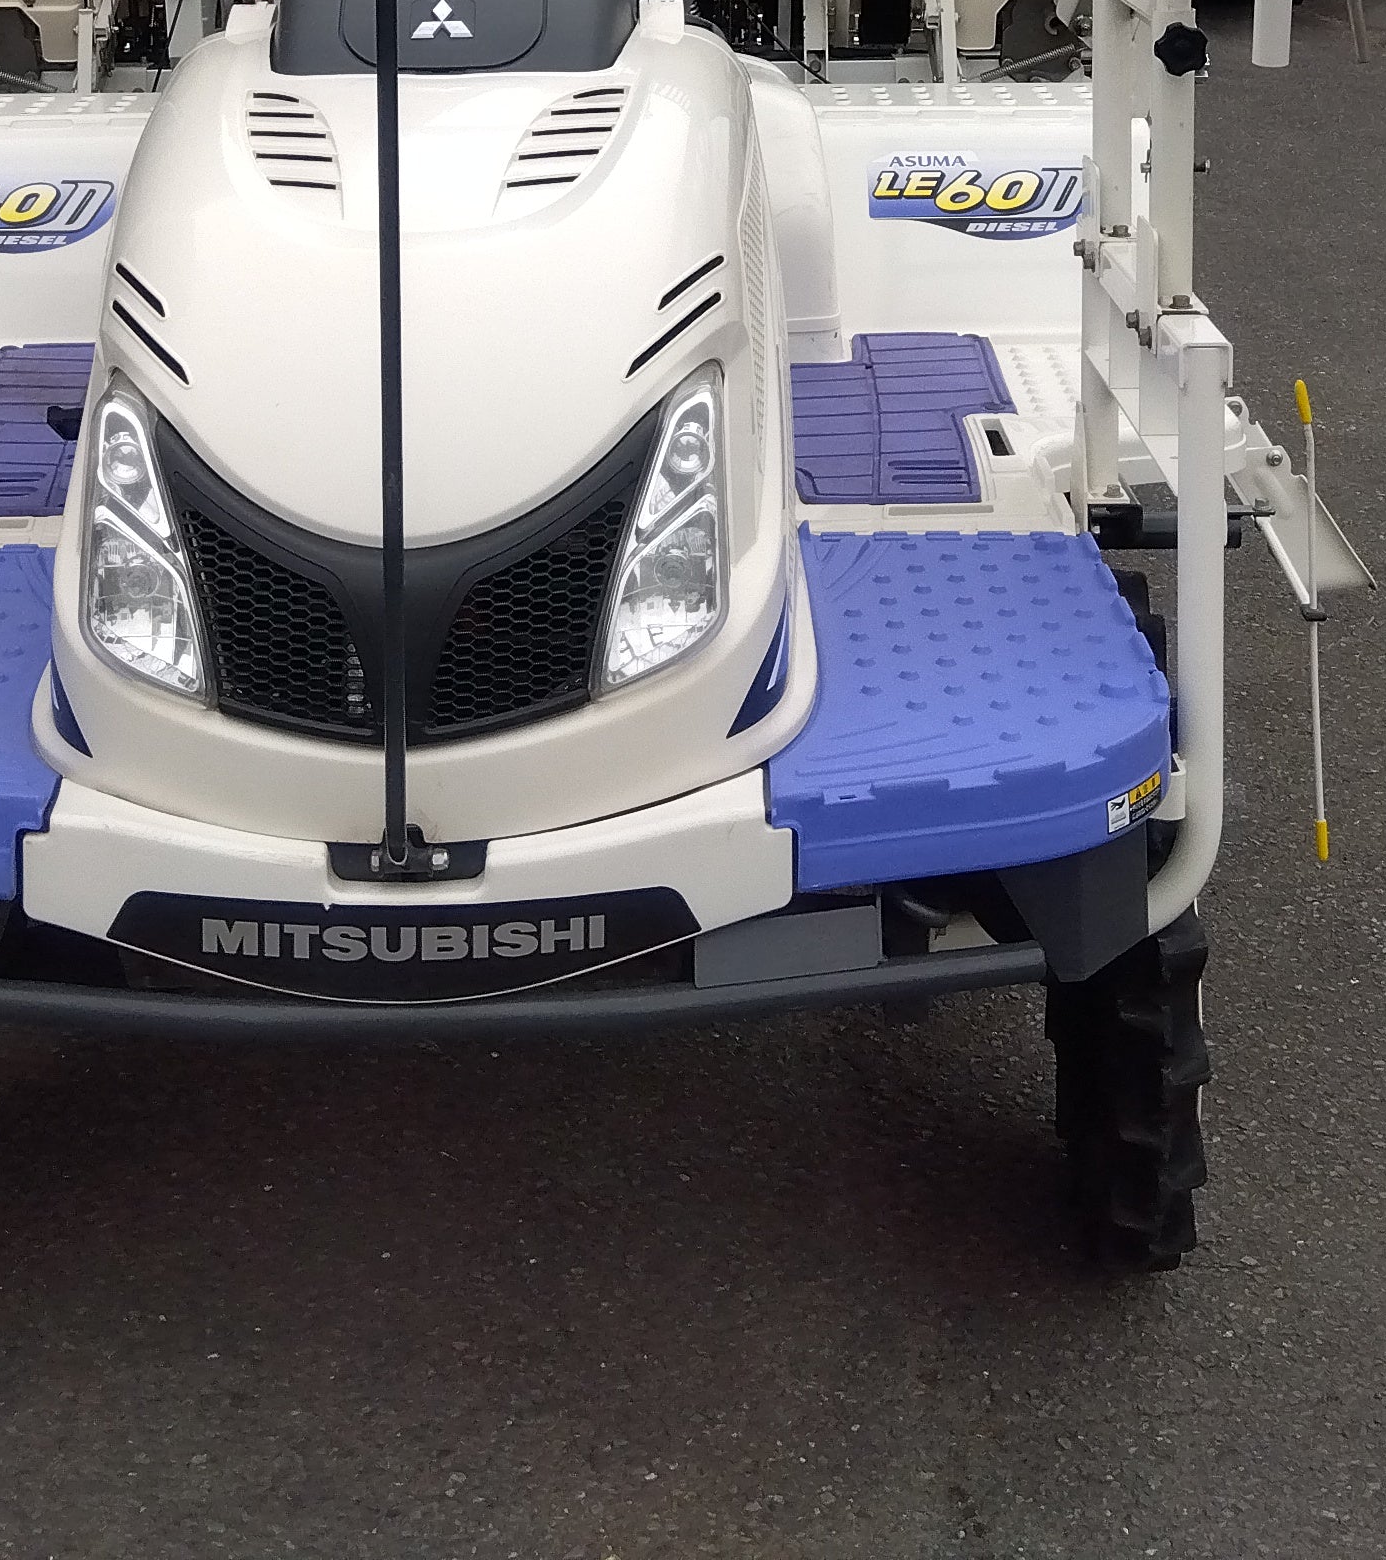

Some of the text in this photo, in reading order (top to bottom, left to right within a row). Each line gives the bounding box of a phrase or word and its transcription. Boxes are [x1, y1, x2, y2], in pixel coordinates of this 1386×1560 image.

[889, 155, 967, 168] ASUMA
[966, 221, 1059, 233] DIESEL
[201, 914, 606, 962] MITSUBISHI
